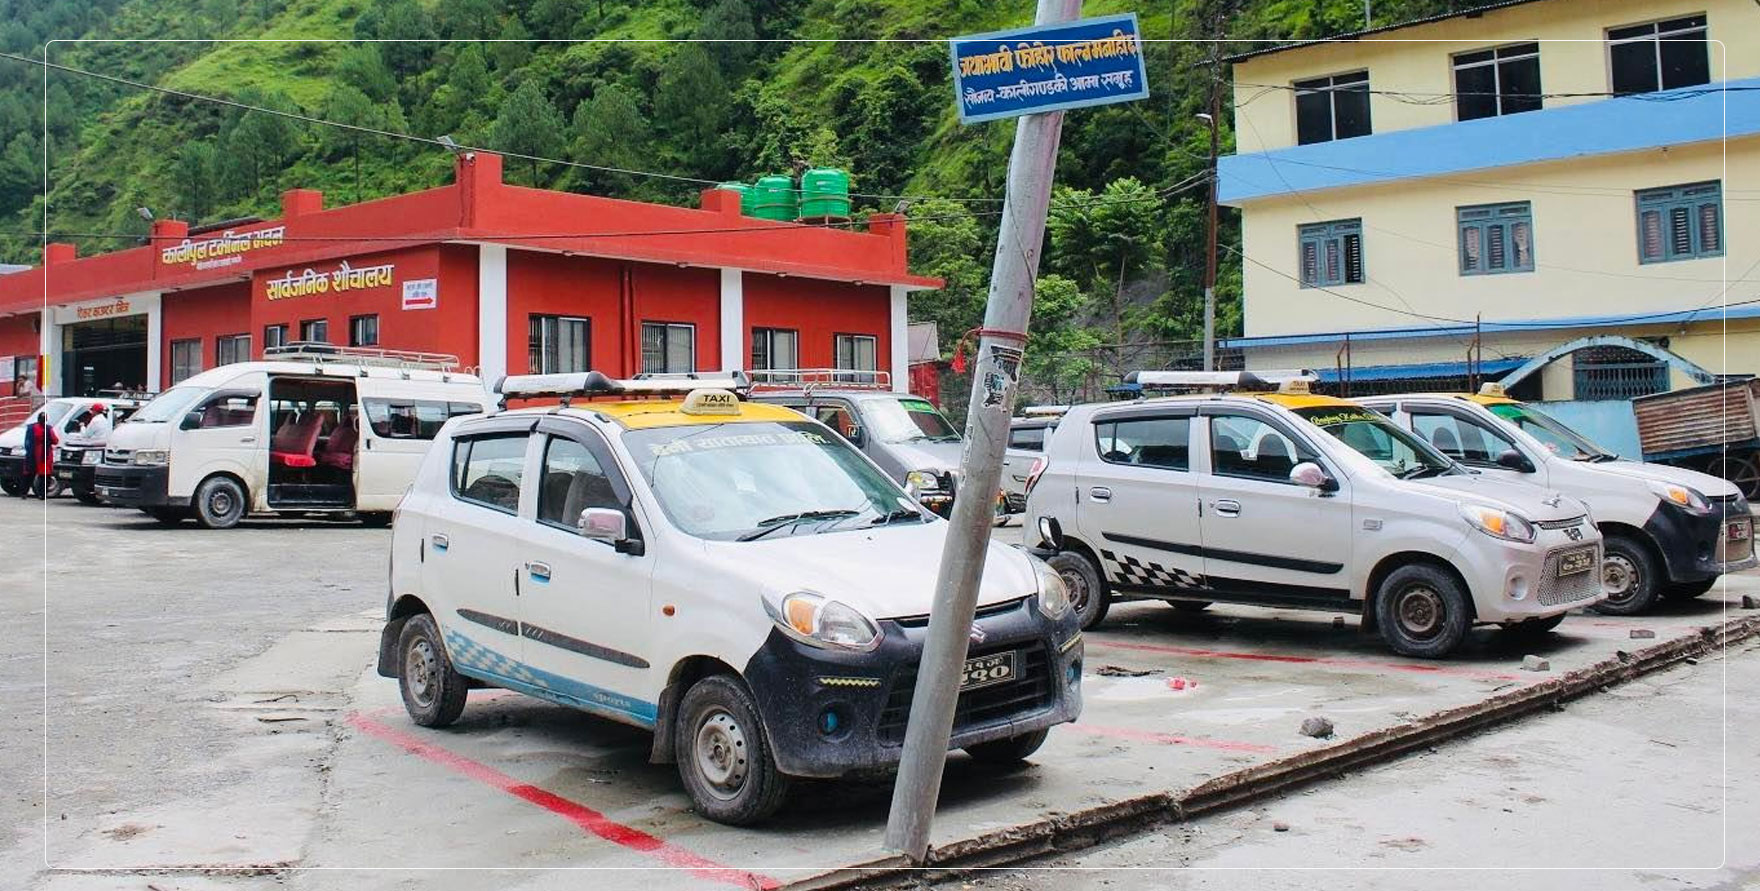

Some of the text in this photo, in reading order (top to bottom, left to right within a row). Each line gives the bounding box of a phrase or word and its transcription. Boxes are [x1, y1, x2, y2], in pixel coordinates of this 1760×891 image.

[265, 268, 330, 301] सार्वजनिक
[331, 260, 395, 293] शौचालय
[703, 394, 731, 403] TAXI
